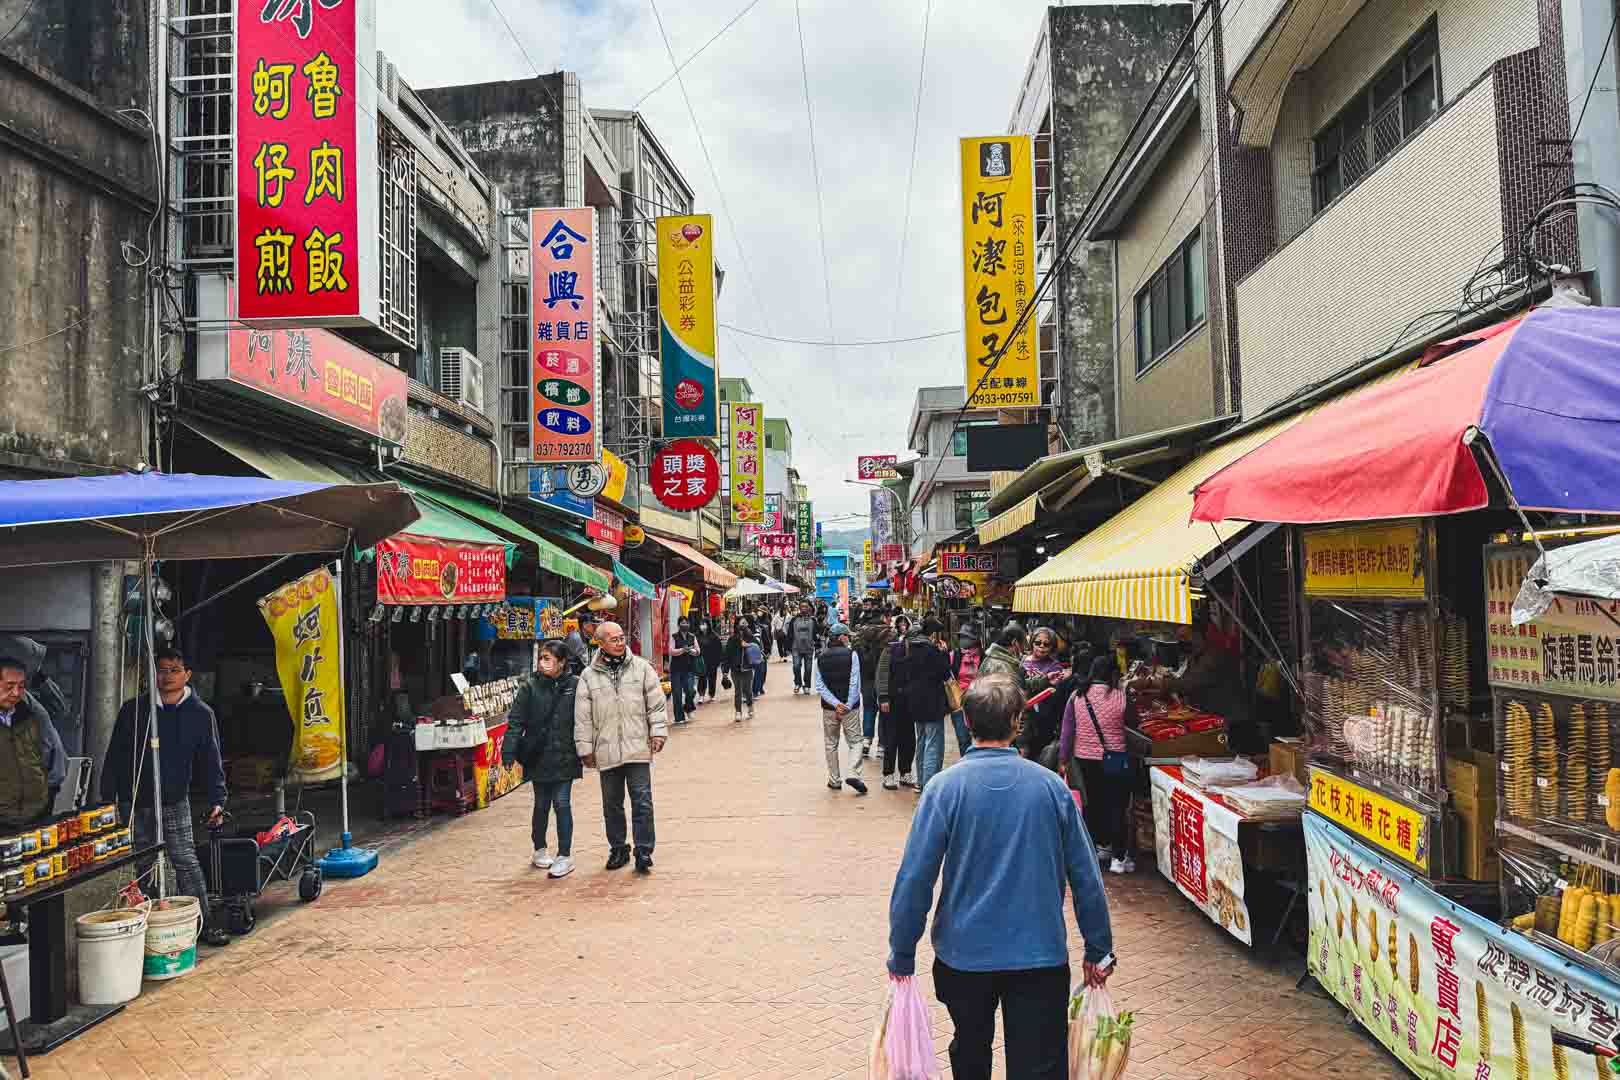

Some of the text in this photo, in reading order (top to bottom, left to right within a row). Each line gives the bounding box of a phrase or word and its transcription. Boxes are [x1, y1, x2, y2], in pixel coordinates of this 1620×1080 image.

[251, 58, 296, 296] 蚵仔煎
[303, 52, 348, 294] 魯肉飯
[540, 219, 588, 311] 合興
[971, 191, 1008, 369] 阿潔包子
[1011, 214, 1031, 361] (來自河南家味)
[677, 258, 697, 332] 公益彩券
[537, 321, 590, 342] 雜貨店
[247, 330, 319, 393] 阿珠
[545, 351, 580, 374] 菸酒
[544, 380, 581, 403] 檳榔
[972, 391, 1033, 404] 0933-907591
[536, 443, 592, 457] 037-792370
[545, 411, 581, 433] 飲料
[663, 454, 706, 474] 頭獎
[663, 477, 706, 497] 之家
[1541, 631, 1620, 687] 旋轉馬鈴
[1315, 778, 1412, 851] 花枝丸棉花糖
[1430, 915, 1462, 1069] 專賣店
